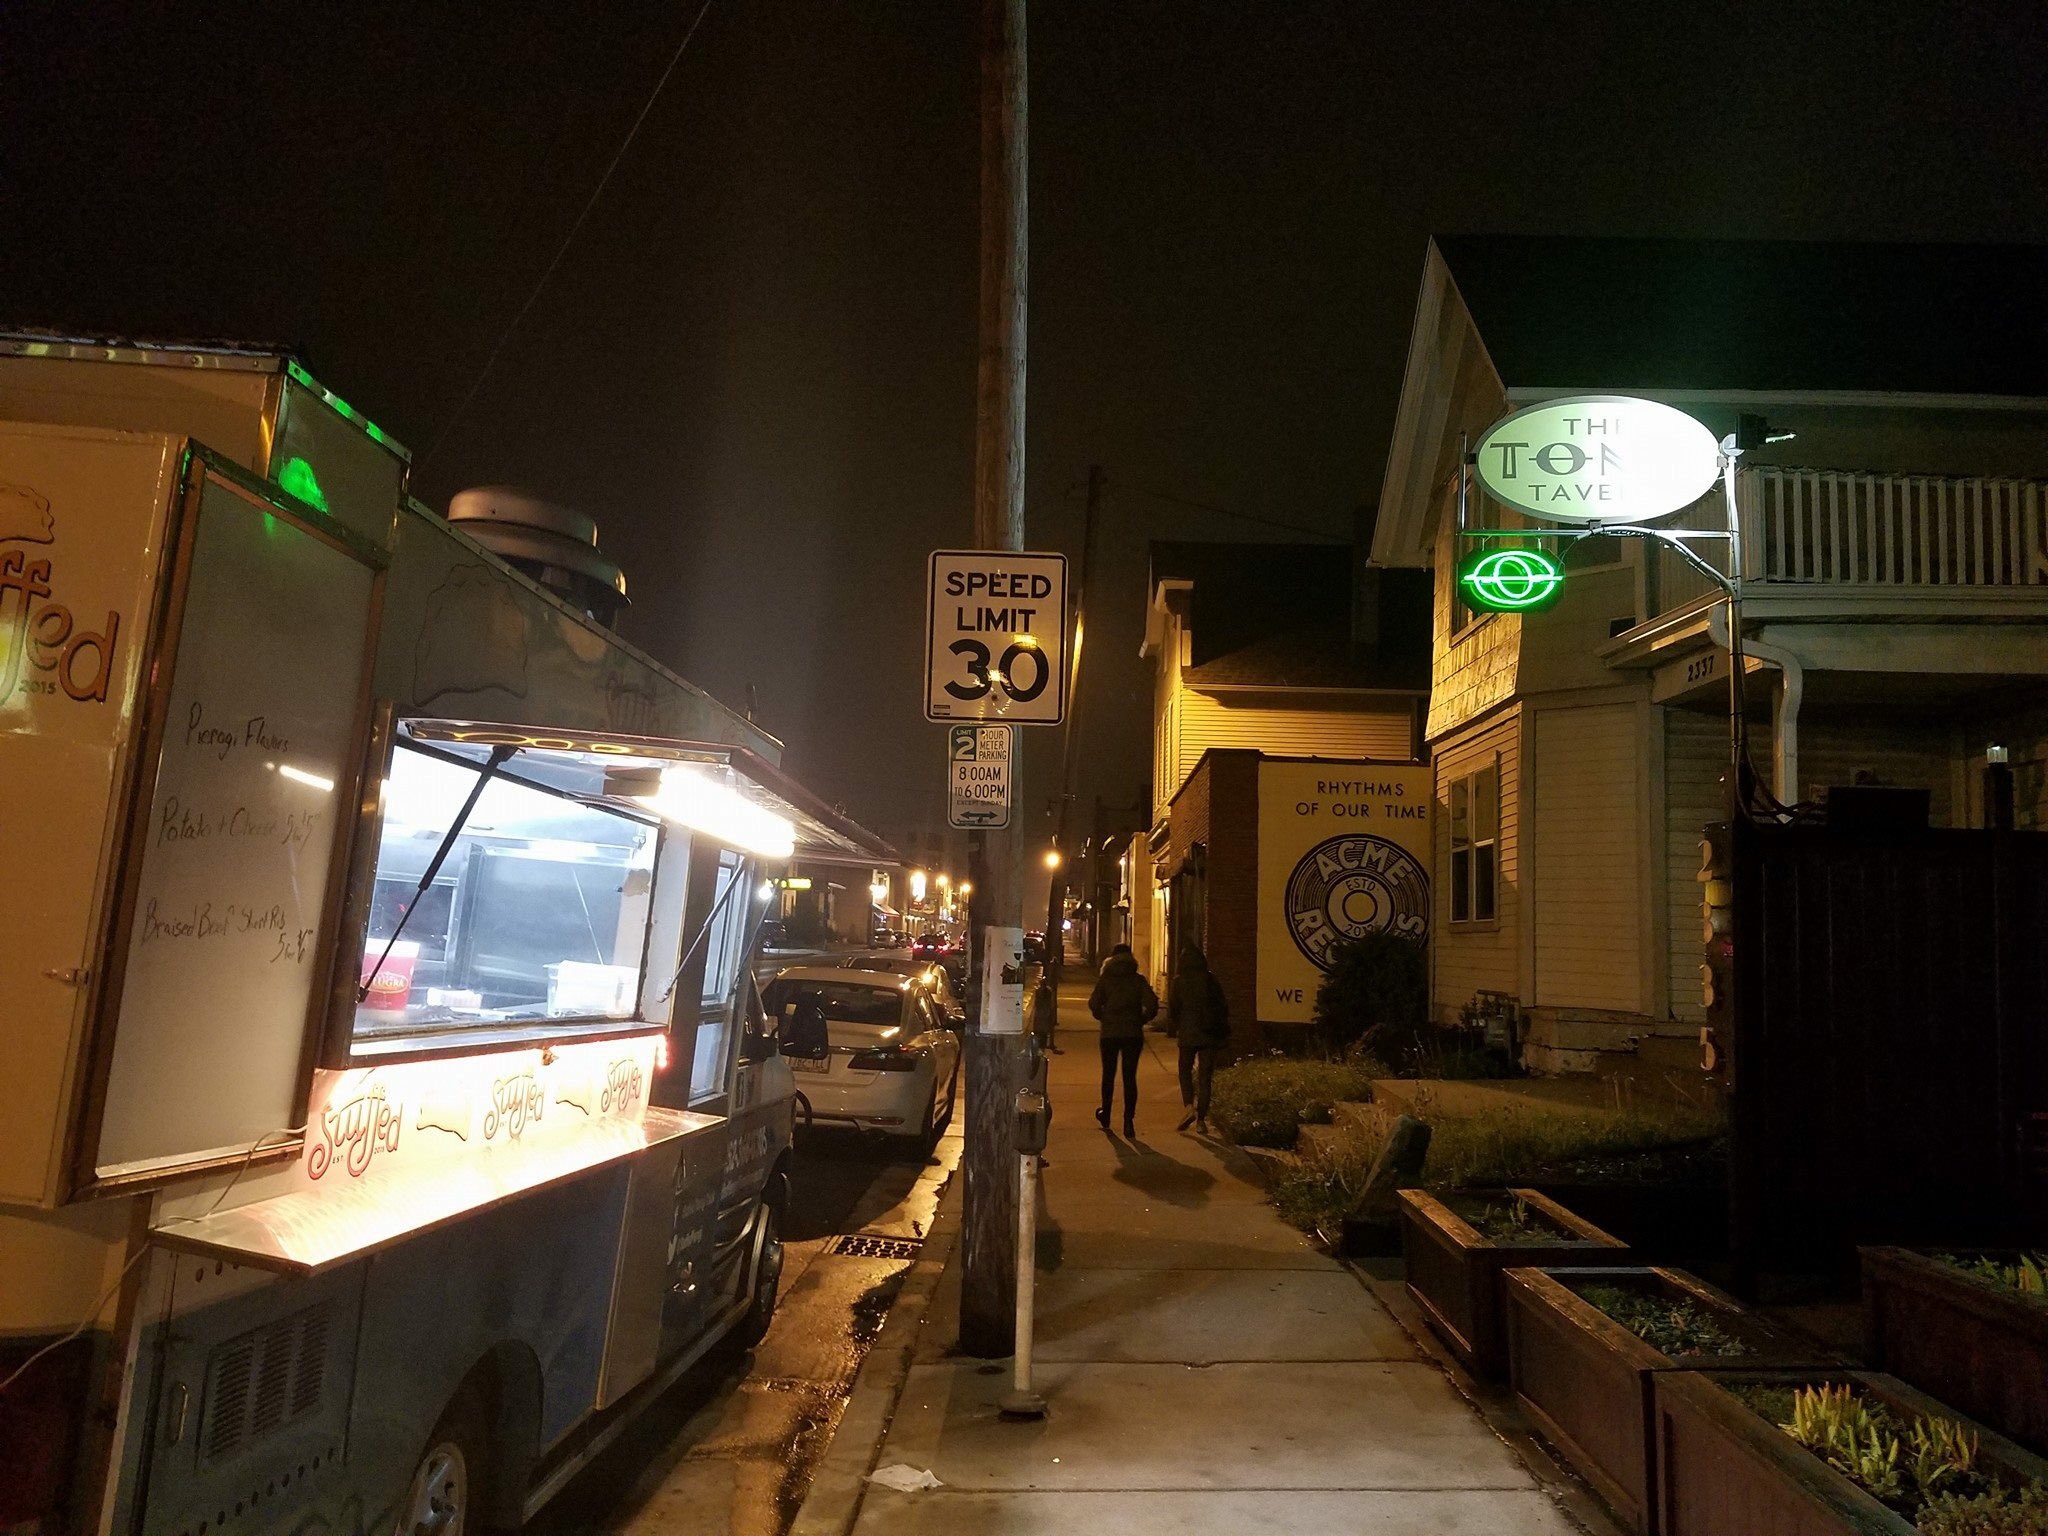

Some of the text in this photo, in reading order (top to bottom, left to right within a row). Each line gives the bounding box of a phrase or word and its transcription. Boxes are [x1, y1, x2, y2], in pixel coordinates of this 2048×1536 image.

[945, 571, 1052, 599] SPEED
[956, 606, 1037, 633] LIMIT
[944, 638, 1050, 703] 30
[1687, 654, 1715, 683] 2337
[18, 680, 57, 695] 2015
[955, 736, 975, 760] 2
[978, 750, 1007, 760] PARKING
[979, 740, 1004, 750] METER
[954, 786, 963, 797] TO
[1316, 780, 1405, 797] RHYTHMS
[1295, 801, 1427, 820] OF OUR TIME
[1314, 840, 1414, 886] ACME
[140, 897, 198, 946] Braised
[1275, 988, 1304, 1003] WE
[484, 1073, 545, 1140] Stuffed
[307, 1092, 404, 1181] Stuffed
